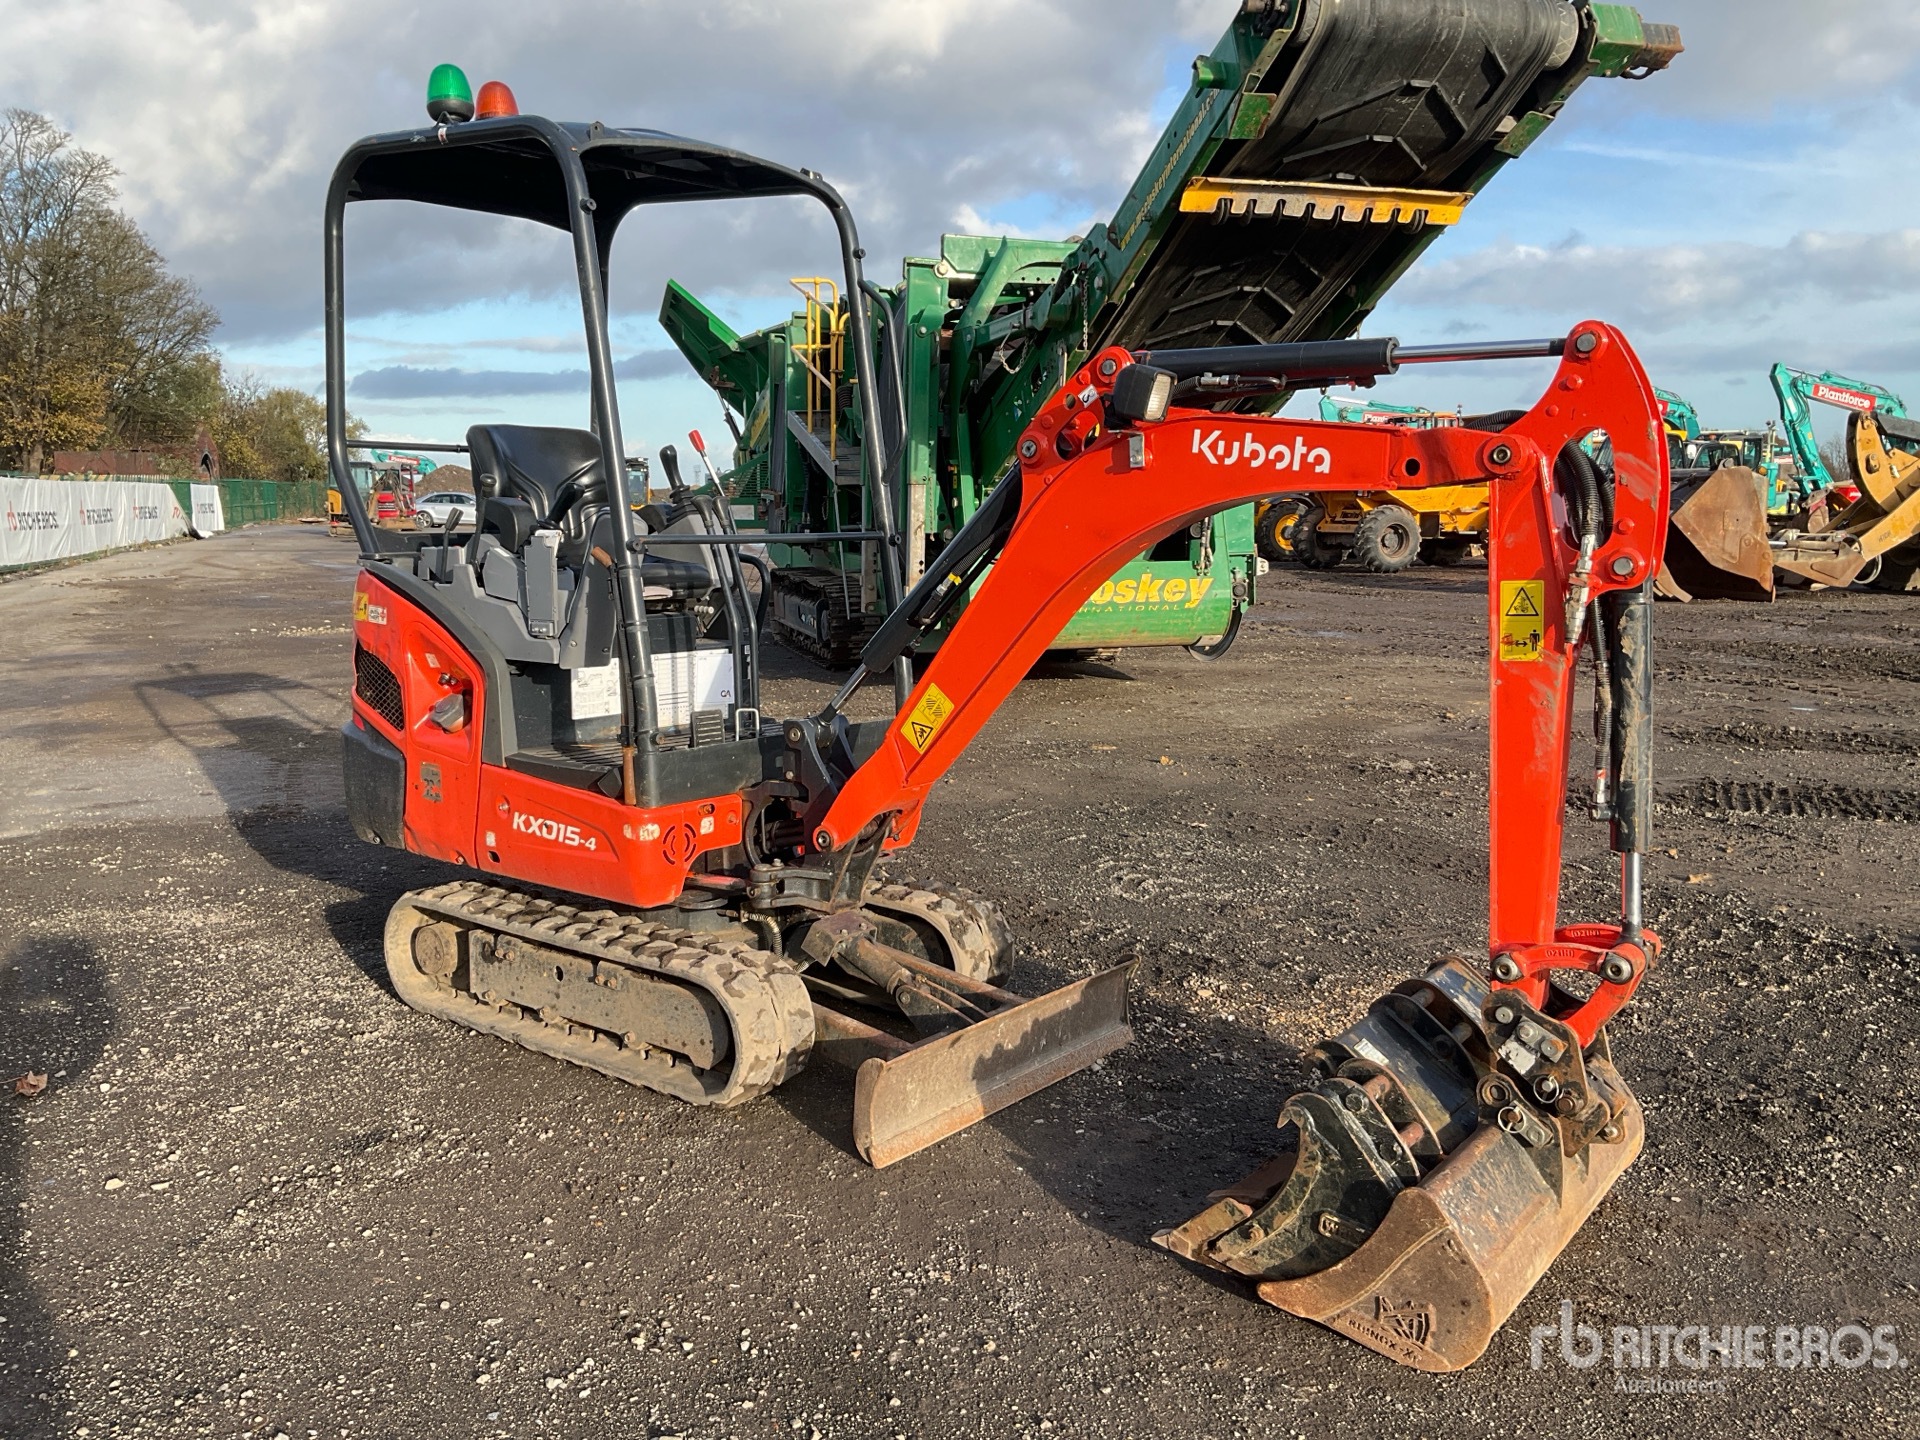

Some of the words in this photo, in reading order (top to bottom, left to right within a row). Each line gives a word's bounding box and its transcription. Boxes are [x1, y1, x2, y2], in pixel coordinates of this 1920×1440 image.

[1817, 386, 1871, 408] Plantforce
[1191, 428, 1331, 474] Kubota
[512, 811, 597, 851] KX015-4
